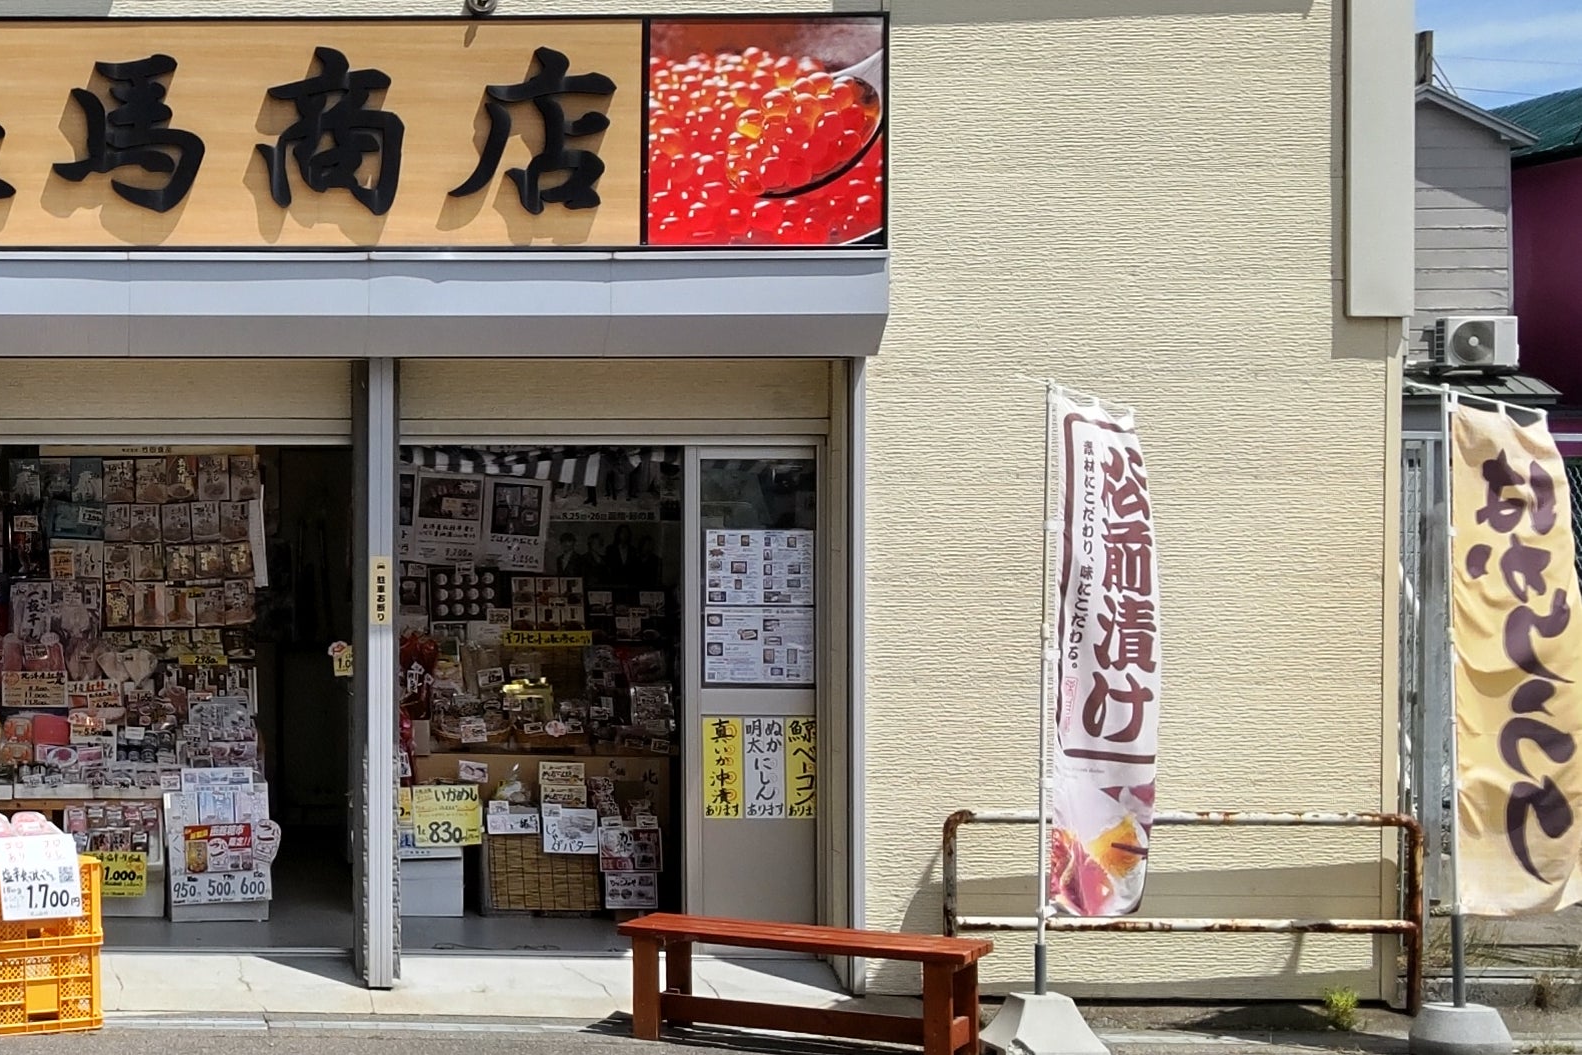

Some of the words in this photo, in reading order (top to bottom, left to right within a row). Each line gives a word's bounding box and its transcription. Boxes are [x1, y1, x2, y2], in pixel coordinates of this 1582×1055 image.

[1081, 446, 1157, 743] 松前漬け
[765, 720, 784, 753] ぬか
[754, 757, 777, 800] にしん
[434, 787, 478, 802] いかめし
[706, 803, 739, 817] あります
[747, 803, 784, 817] あります
[788, 804, 816, 817] ありま
